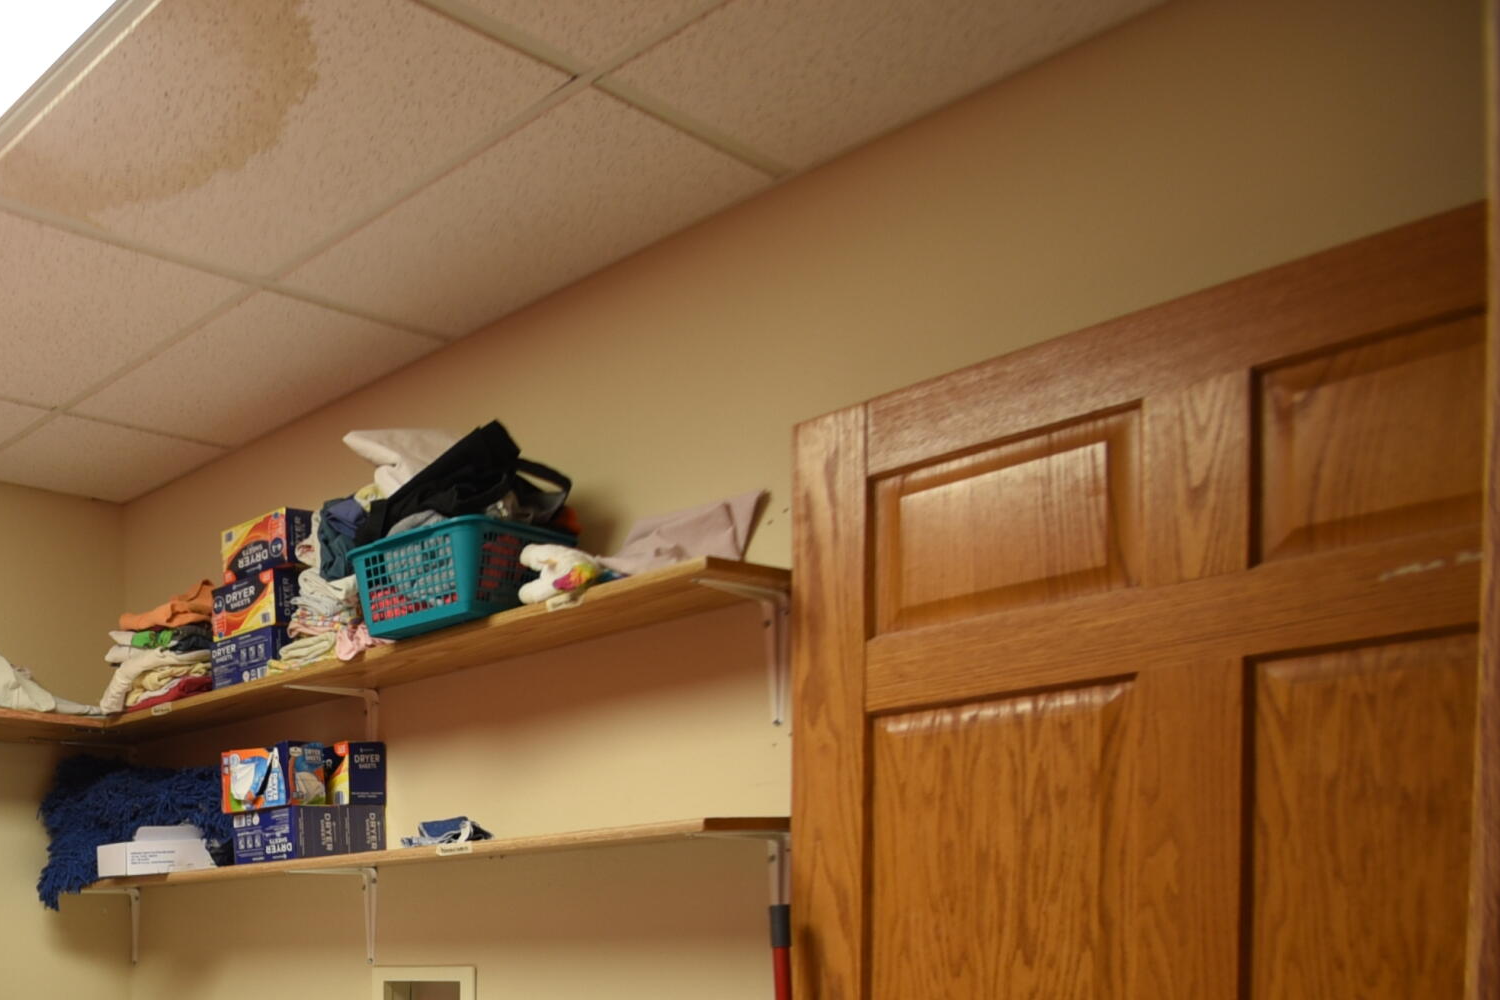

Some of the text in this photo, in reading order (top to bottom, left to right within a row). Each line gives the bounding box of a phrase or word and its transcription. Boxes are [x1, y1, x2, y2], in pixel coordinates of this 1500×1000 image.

[238, 549, 268, 568] DRYER
[225, 585, 256, 603] DRYER
[230, 597, 251, 609] SHEETS
[212, 644, 237, 658] DRYER
[354, 754, 380, 764] DRYER
[324, 812, 333, 851] DRYER
[369, 812, 378, 850] DRYER
[265, 843, 293, 855] DRYER
